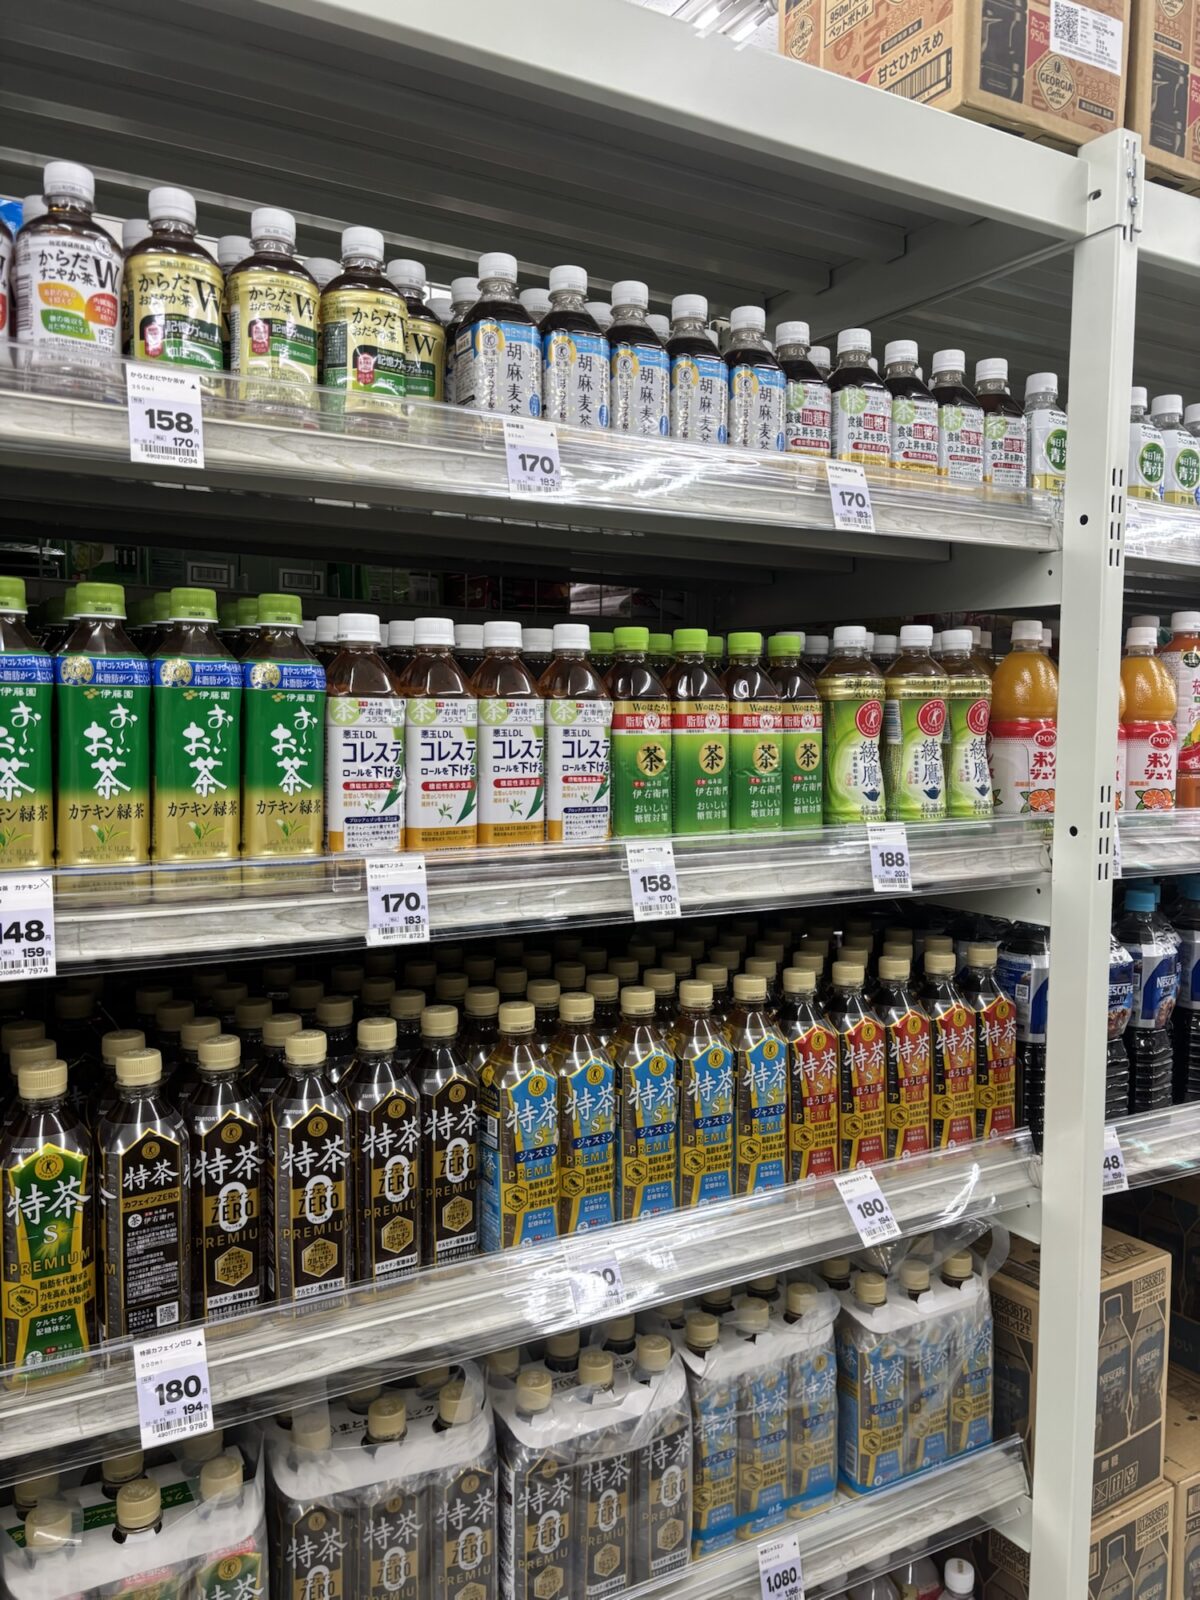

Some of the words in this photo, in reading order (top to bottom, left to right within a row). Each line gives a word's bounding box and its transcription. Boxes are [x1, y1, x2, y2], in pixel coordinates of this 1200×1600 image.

[829, 4, 869, 37] ペットボトル
[877, 30, 944, 86] 甘さひかえめ
[1040, 73, 1073, 93] GEORGIA
[38, 249, 90, 271] からだ
[93, 256, 120, 293] W
[139, 273, 190, 292] からだ
[249, 287, 291, 306] からだ
[352, 307, 397, 329] からだ
[411, 333, 438, 357] W
[144, 407, 194, 434] 158
[172, 436, 194, 449] 170
[519, 453, 555, 475] 170
[1143, 461, 1163, 475] 青汁
[1179, 466, 1199, 481] 青汁
[540, 477, 556, 487] 183
[839, 491, 866, 508] 170
[0, 687, 36, 697] 伊藤園
[100, 689, 134, 699] 伊藤園
[198, 691, 230, 700] 伊藤園
[286, 693, 315, 703] 伊藤園
[343, 729, 377, 739] 悪玉LDL
[421, 729, 454, 739] 悪玉LDL
[492, 728, 524, 738] 悪玉LDL
[562, 728, 591, 738] 悪玉LDL
[1152, 737, 1171, 746] POM
[343, 741, 402, 763] コレステ
[421, 741, 476, 762] コレステ
[492, 739, 543, 760] コレステ
[562, 739, 610, 759] コレステ
[640, 745, 664, 773] 茶
[702, 744, 724, 771] 茶
[756, 744, 776, 770] 茶
[799, 743, 818, 769] 茶
[84, 722, 131, 800] お茶
[182, 722, 227, 798] お茶
[271, 723, 313, 796] お茶
[492, 761, 543, 775] ロールを下げる
[562, 760, 609, 773] ロールを下げる
[860, 740, 881, 787] 綾鷹
[921, 737, 944, 785] 綾鷹
[970, 737, 988, 783] 綾鷹
[1032, 751, 1056, 768] ポン
[1146, 753, 1172, 768] ポン
[343, 765, 401, 779] ロールを下げる
[421, 763, 476, 777] ロールを下げる
[1144, 769, 1172, 780] ジュース
[632, 788, 669, 799] 伊右衛門
[695, 786, 728, 797] 伊右衛門
[749, 785, 781, 796] 伊右衛門
[792, 782, 822, 793] 伊右衛門
[68, 801, 145, 820] カテキン緑茶
[167, 801, 238, 819] カテキン緑茶
[255, 798, 321, 816] カテキン緑茶
[634, 803, 668, 813] おいしい
[696, 801, 728, 811] おいしい
[750, 799, 780, 809] おいしい
[794, 796, 822, 806] おいしい
[879, 851, 905, 868] 188
[640, 874, 672, 893] 158
[894, 870, 906, 878] 203
[381, 892, 420, 913] 170
[659, 895, 673, 903] 170
[404, 915, 421, 925] 183
[22, 947, 45, 958] 159
[28, 967, 48, 975] 7974
[935, 1025, 975, 1056] 特茶
[979, 1017, 1016, 1047] 特茶
[844, 1039, 885, 1073] 特茶
[889, 1032, 930, 1064] 特茶
[793, 1048, 837, 1082] 特茶
[948, 1067, 973, 1079] ほうじ茶
[687, 1066, 733, 1102] 特茶
[743, 1057, 787, 1095] 特茶
[902, 1076, 928, 1088] ほうじ茶
[627, 1072, 677, 1112] 特茶
[856, 1083, 883, 1096] ほうじ茶
[564, 1082, 616, 1121] 特茶
[806, 1094, 835, 1106] ほうじ茶
[424, 1100, 478, 1142] 特茶
[506, 1093, 559, 1134] 特茶
[754, 1104, 785, 1118] ジャスミン
[639, 1122, 676, 1138] ジャスミン
[698, 1114, 732, 1129] ジャスミン
[361, 1115, 421, 1160] 特茶
[576, 1132, 614, 1149] ジャスミン
[193, 1140, 265, 1187] 特茶
[281, 1135, 350, 1178] 特茶
[440, 1151, 475, 1176] ZERO
[518, 1146, 557, 1163] ジャスミン
[122, 1159, 180, 1192] 特茶
[381, 1163, 413, 1177] カフェイン
[301, 1183, 337, 1198] カフェイン
[378, 1171, 415, 1196] ZERO
[6, 1175, 91, 1226] 特茶
[123, 1190, 179, 1209] カフェインZERO
[213, 1191, 252, 1205] カフェイン
[298, 1193, 340, 1216] ZERO
[857, 1197, 884, 1219] 180
[211, 1199, 254, 1225] ZERO
[43, 1224, 59, 1244] S
[10, 1246, 90, 1275] PREMIUM
[220, 1262, 249, 1275] ケルセチン
[307, 1253, 335, 1267] ケルセチン
[35, 1314, 71, 1327] ケルセチン
[863, 1356, 905, 1390] 特茶
[155, 1375, 201, 1406] 180
[182, 1401, 203, 1415] 194
[189, 1420, 208, 1432] 9786
[641, 1430, 691, 1469] 特茶
[582, 1453, 631, 1492] 特茶
[516, 1473, 574, 1515] 特茶
[656, 1477, 687, 1501] ZERO
[436, 1488, 495, 1531] 特茶
[594, 1500, 622, 1526] ZERO
[363, 1509, 423, 1550] 特茶
[532, 1522, 566, 1549] ZERO
[286, 1527, 348, 1569] 特茶
[452, 1539, 488, 1565] ZERO
[377, 1561, 411, 1586] ZERO
[767, 1566, 797, 1593] 1,080
